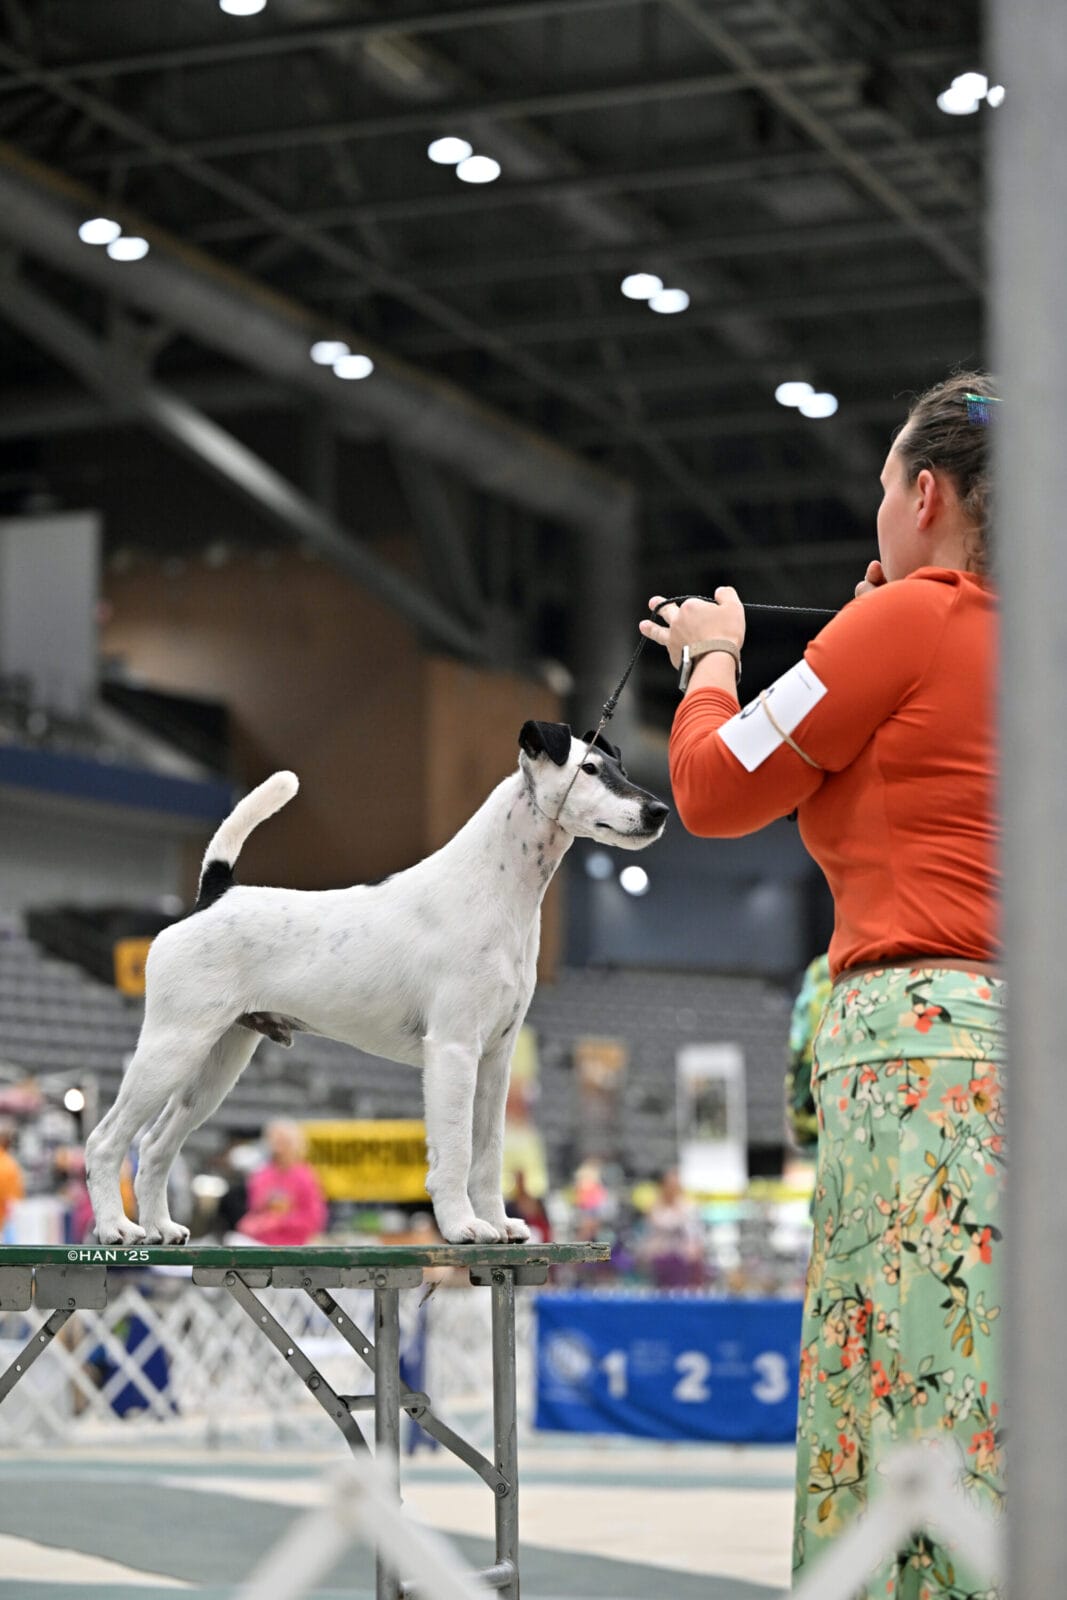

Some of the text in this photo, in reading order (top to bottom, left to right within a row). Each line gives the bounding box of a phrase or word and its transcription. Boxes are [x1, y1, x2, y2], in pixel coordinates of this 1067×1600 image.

[603, 1350, 628, 1399] 1
[673, 1351, 711, 1403] 2
[752, 1352, 789, 1404] 3
